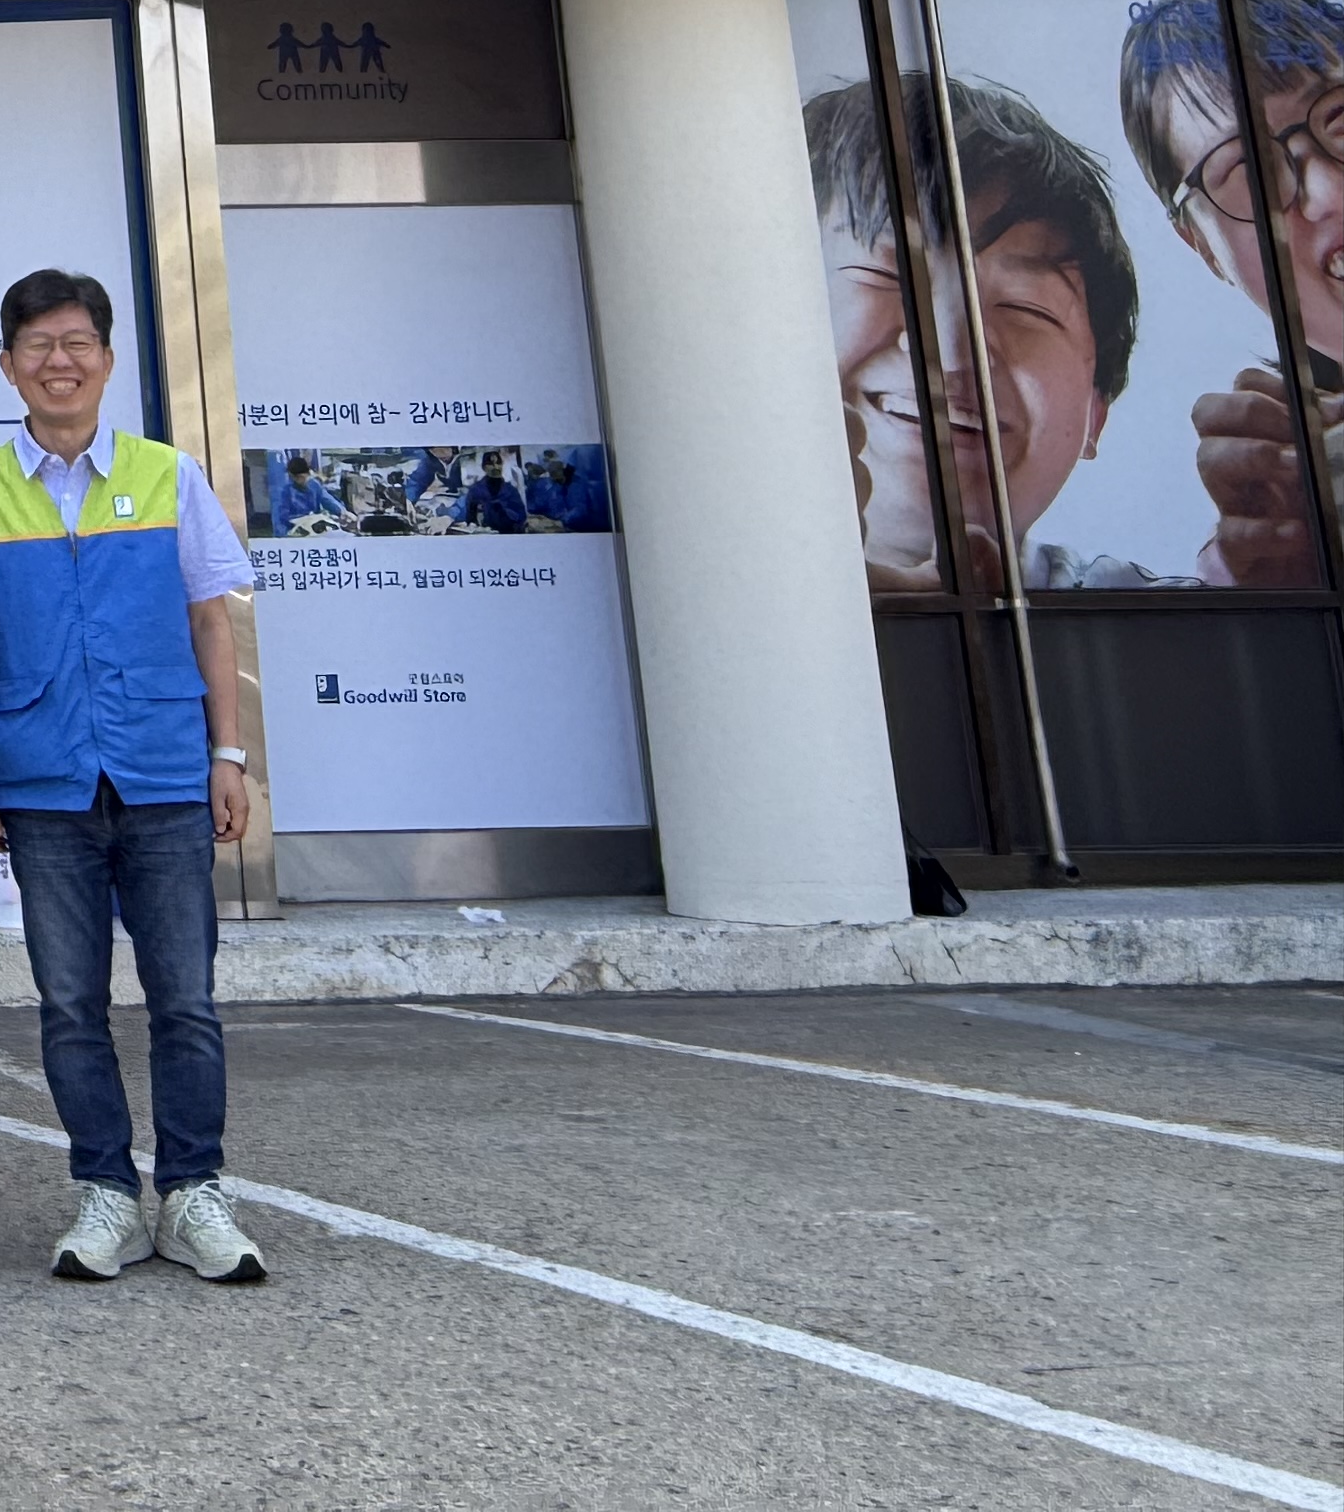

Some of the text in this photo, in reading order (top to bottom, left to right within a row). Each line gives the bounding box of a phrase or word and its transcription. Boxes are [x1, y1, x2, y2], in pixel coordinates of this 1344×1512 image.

[257, 75, 409, 103] Community
[298, 402, 361, 426] 선의에
[409, 399, 522, 425] 감사합니다.
[469, 567, 557, 589] 되었습니다
[343, 688, 467, 705] Goodwill Store
